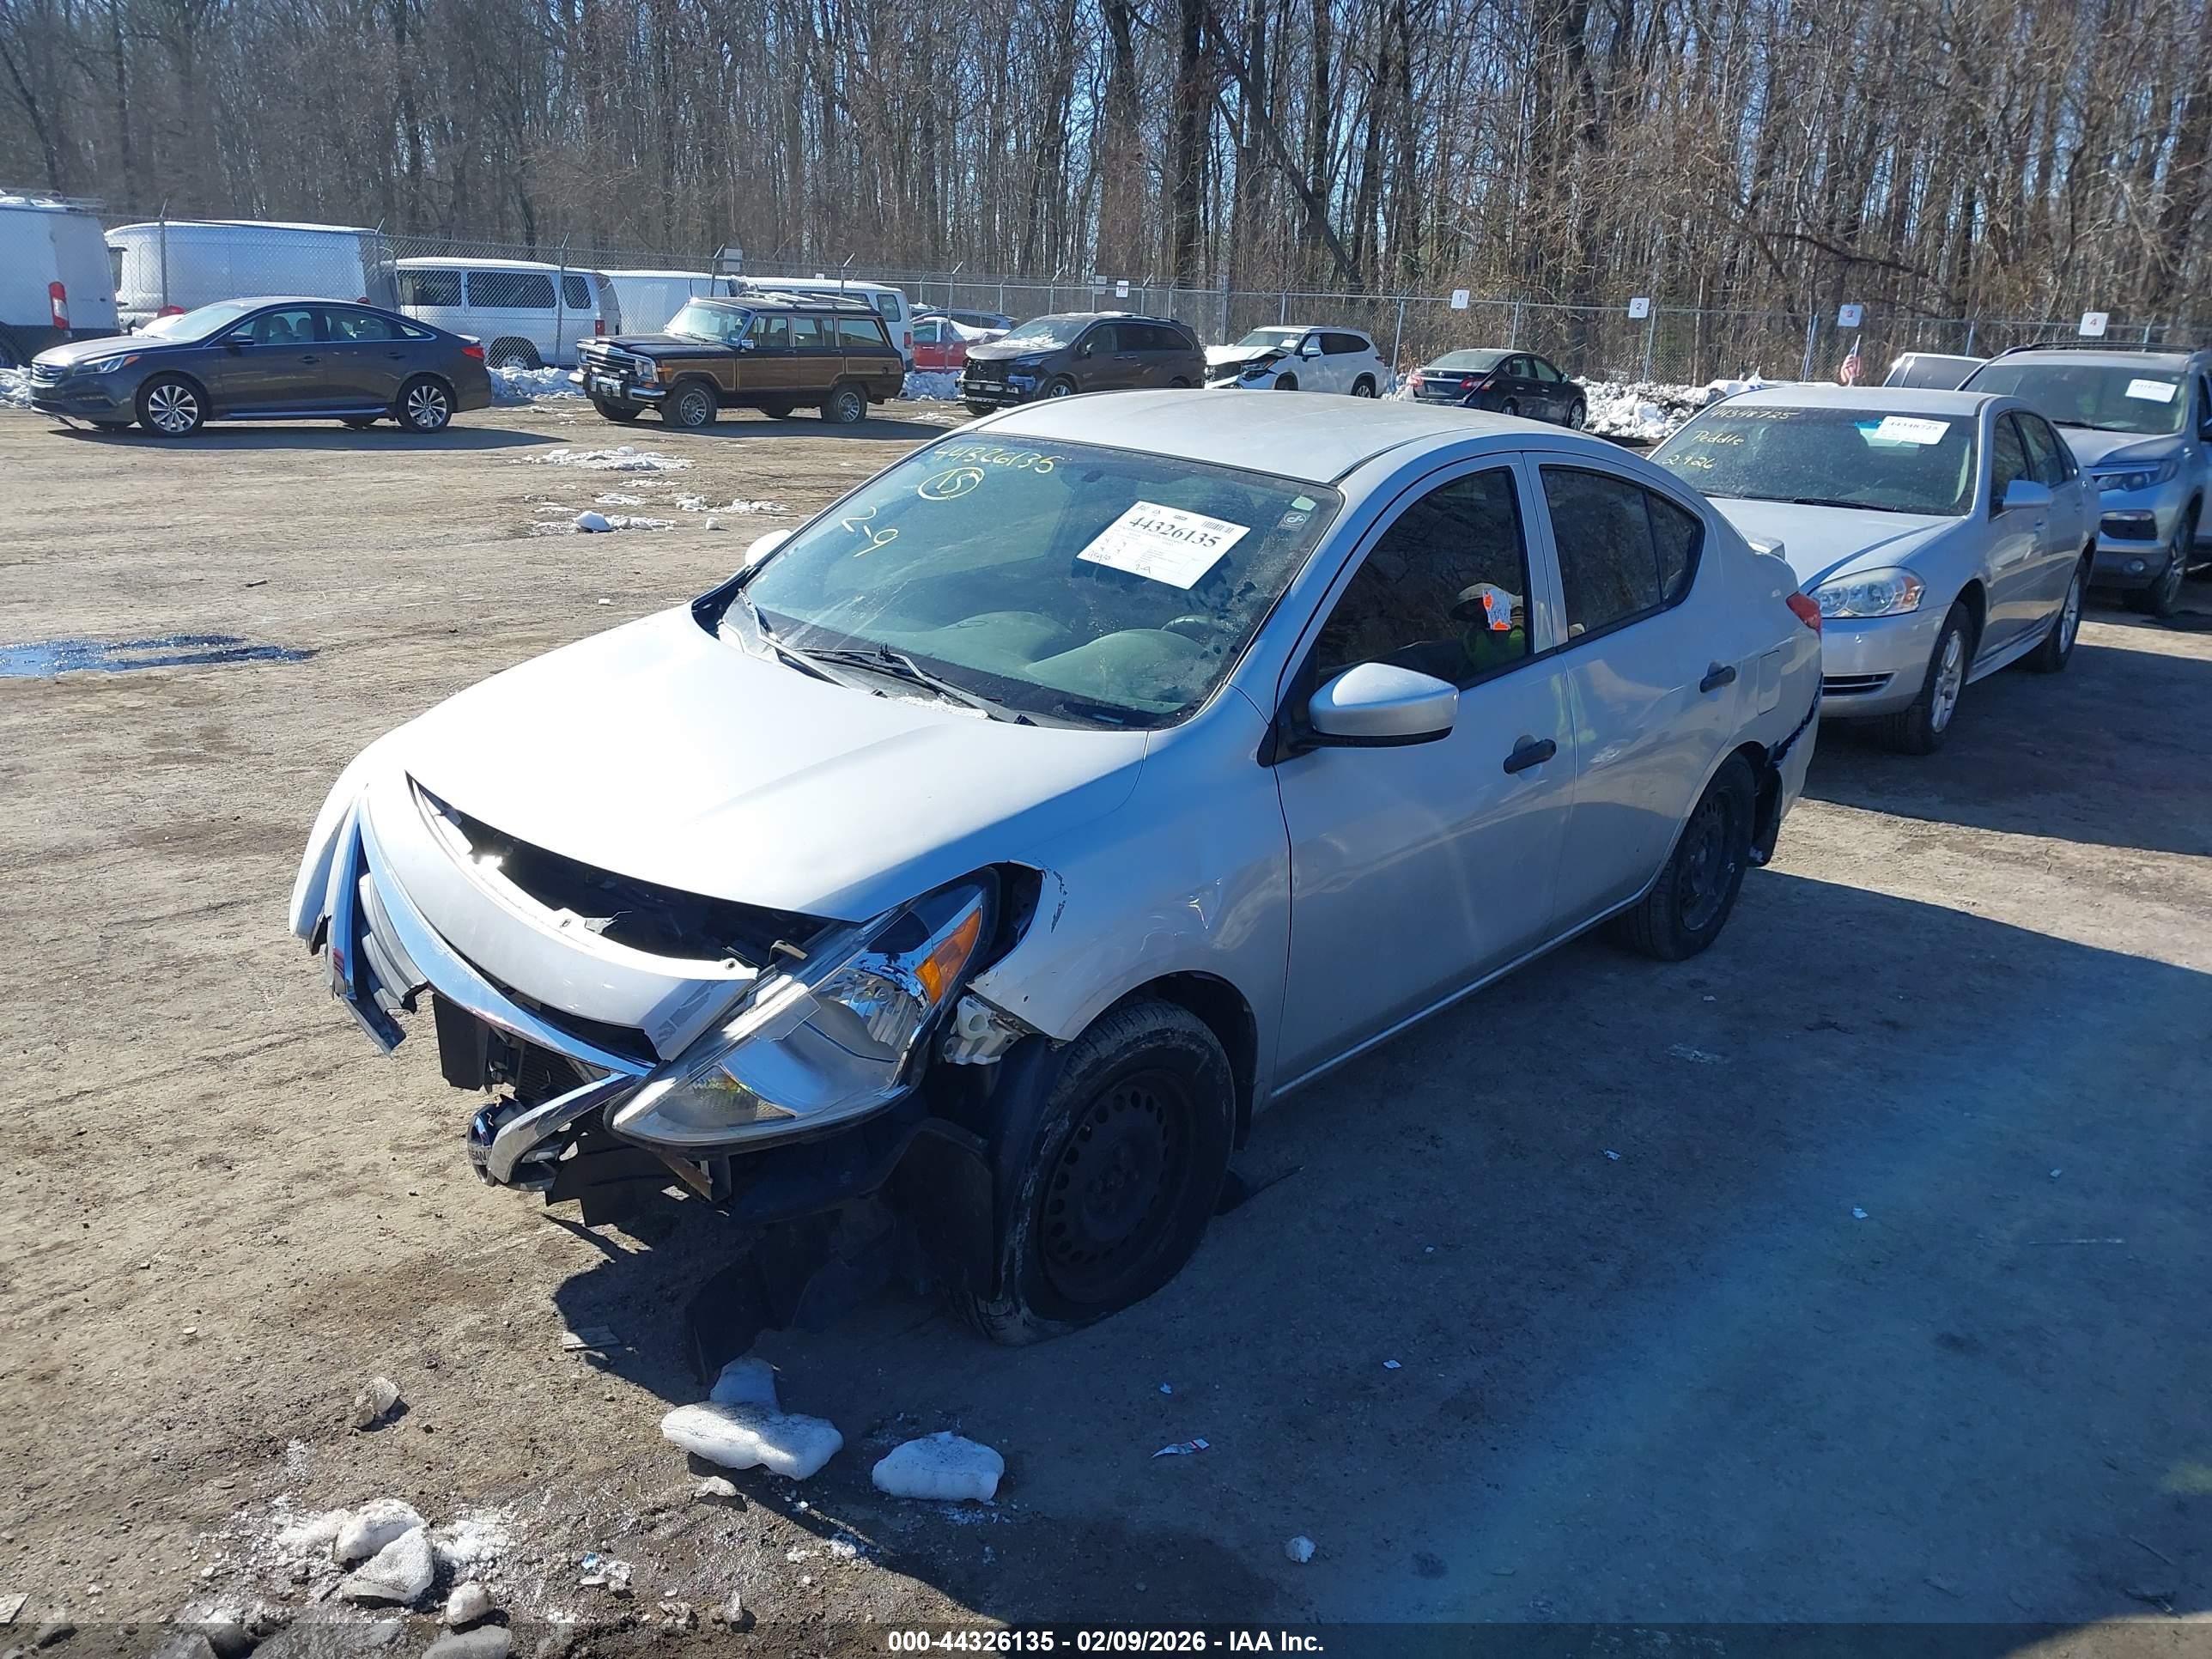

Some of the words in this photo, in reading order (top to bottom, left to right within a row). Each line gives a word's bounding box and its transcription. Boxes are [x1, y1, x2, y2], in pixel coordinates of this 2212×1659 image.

[1846, 309, 1855, 318] 3
[2089, 318, 2098, 326] 4
[934, 446, 1065, 474] 44326135
[1128, 516, 1222, 549] 44326135
